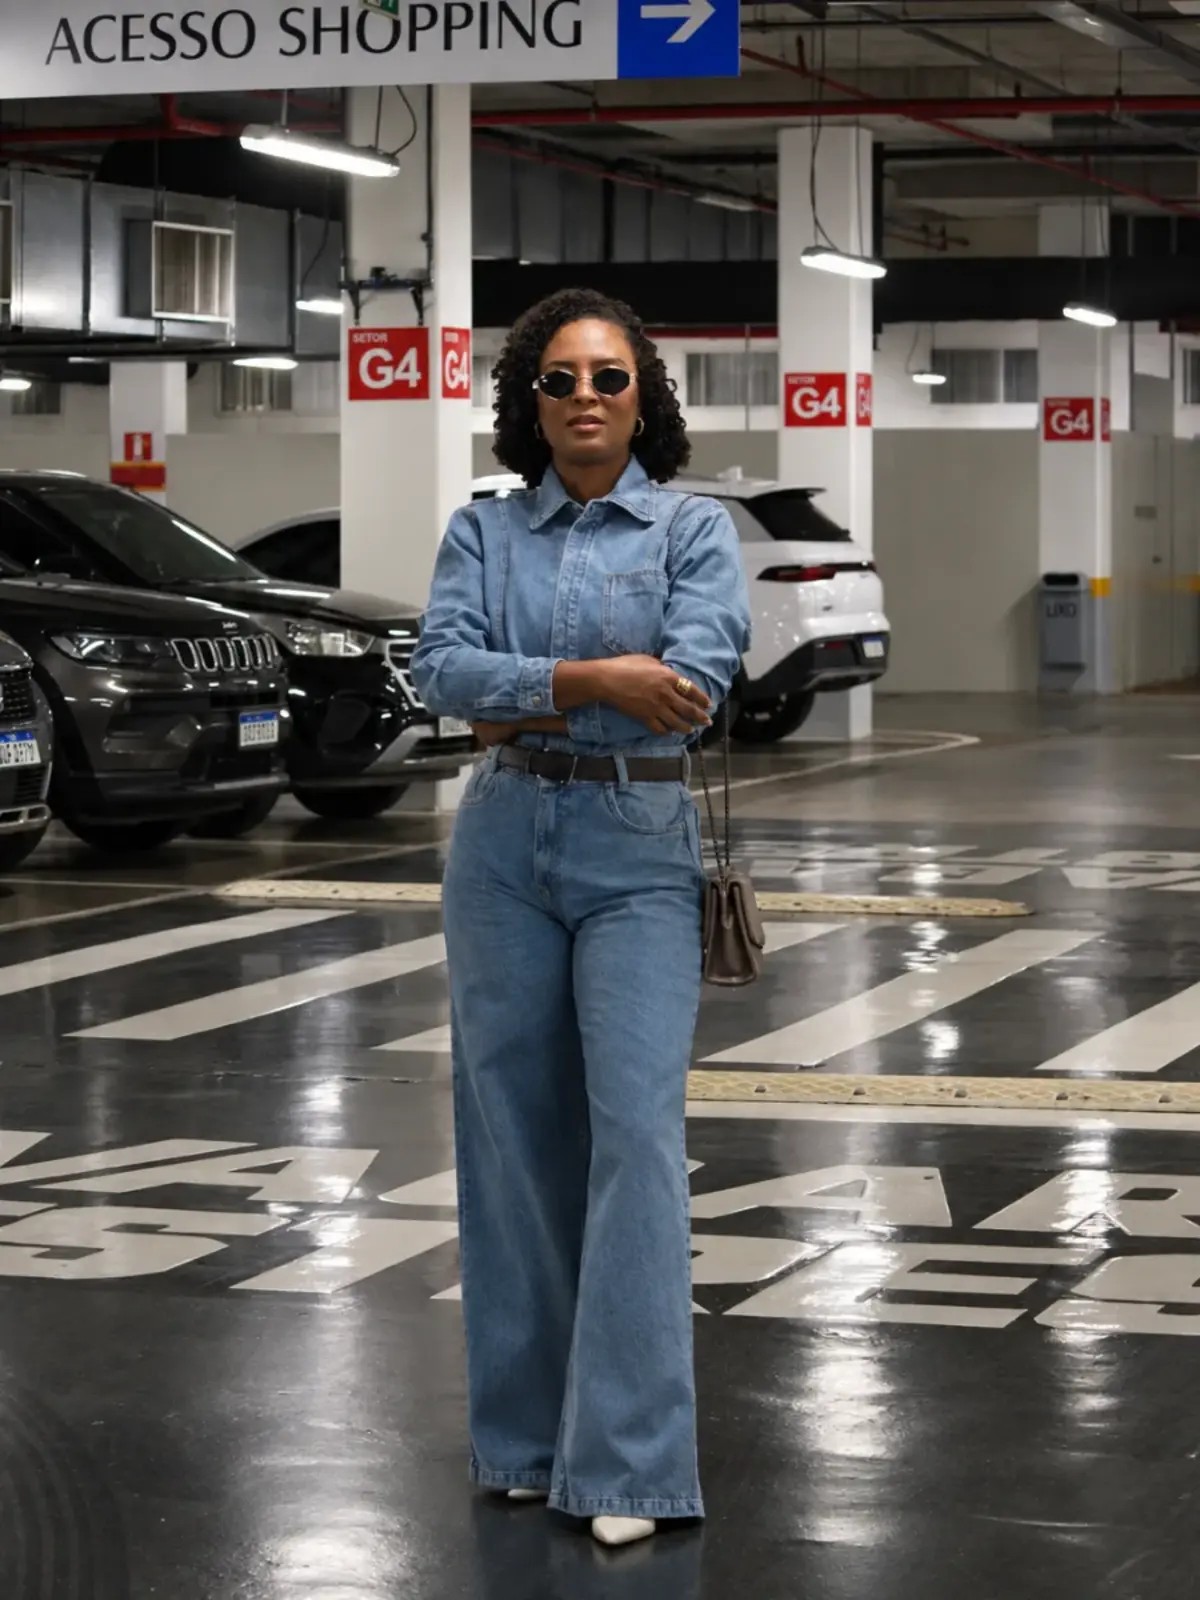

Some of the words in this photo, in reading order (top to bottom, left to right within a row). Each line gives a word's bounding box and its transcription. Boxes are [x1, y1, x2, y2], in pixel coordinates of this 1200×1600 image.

[46, 10, 257, 66] ACESSO
[279, 0, 584, 57] SHOPPING
[353, 332, 388, 344] SETOR
[359, 346, 421, 389] G4
[444, 350, 469, 390] G4
[792, 386, 841, 419] G4
[1051, 408, 1090, 436] G4
